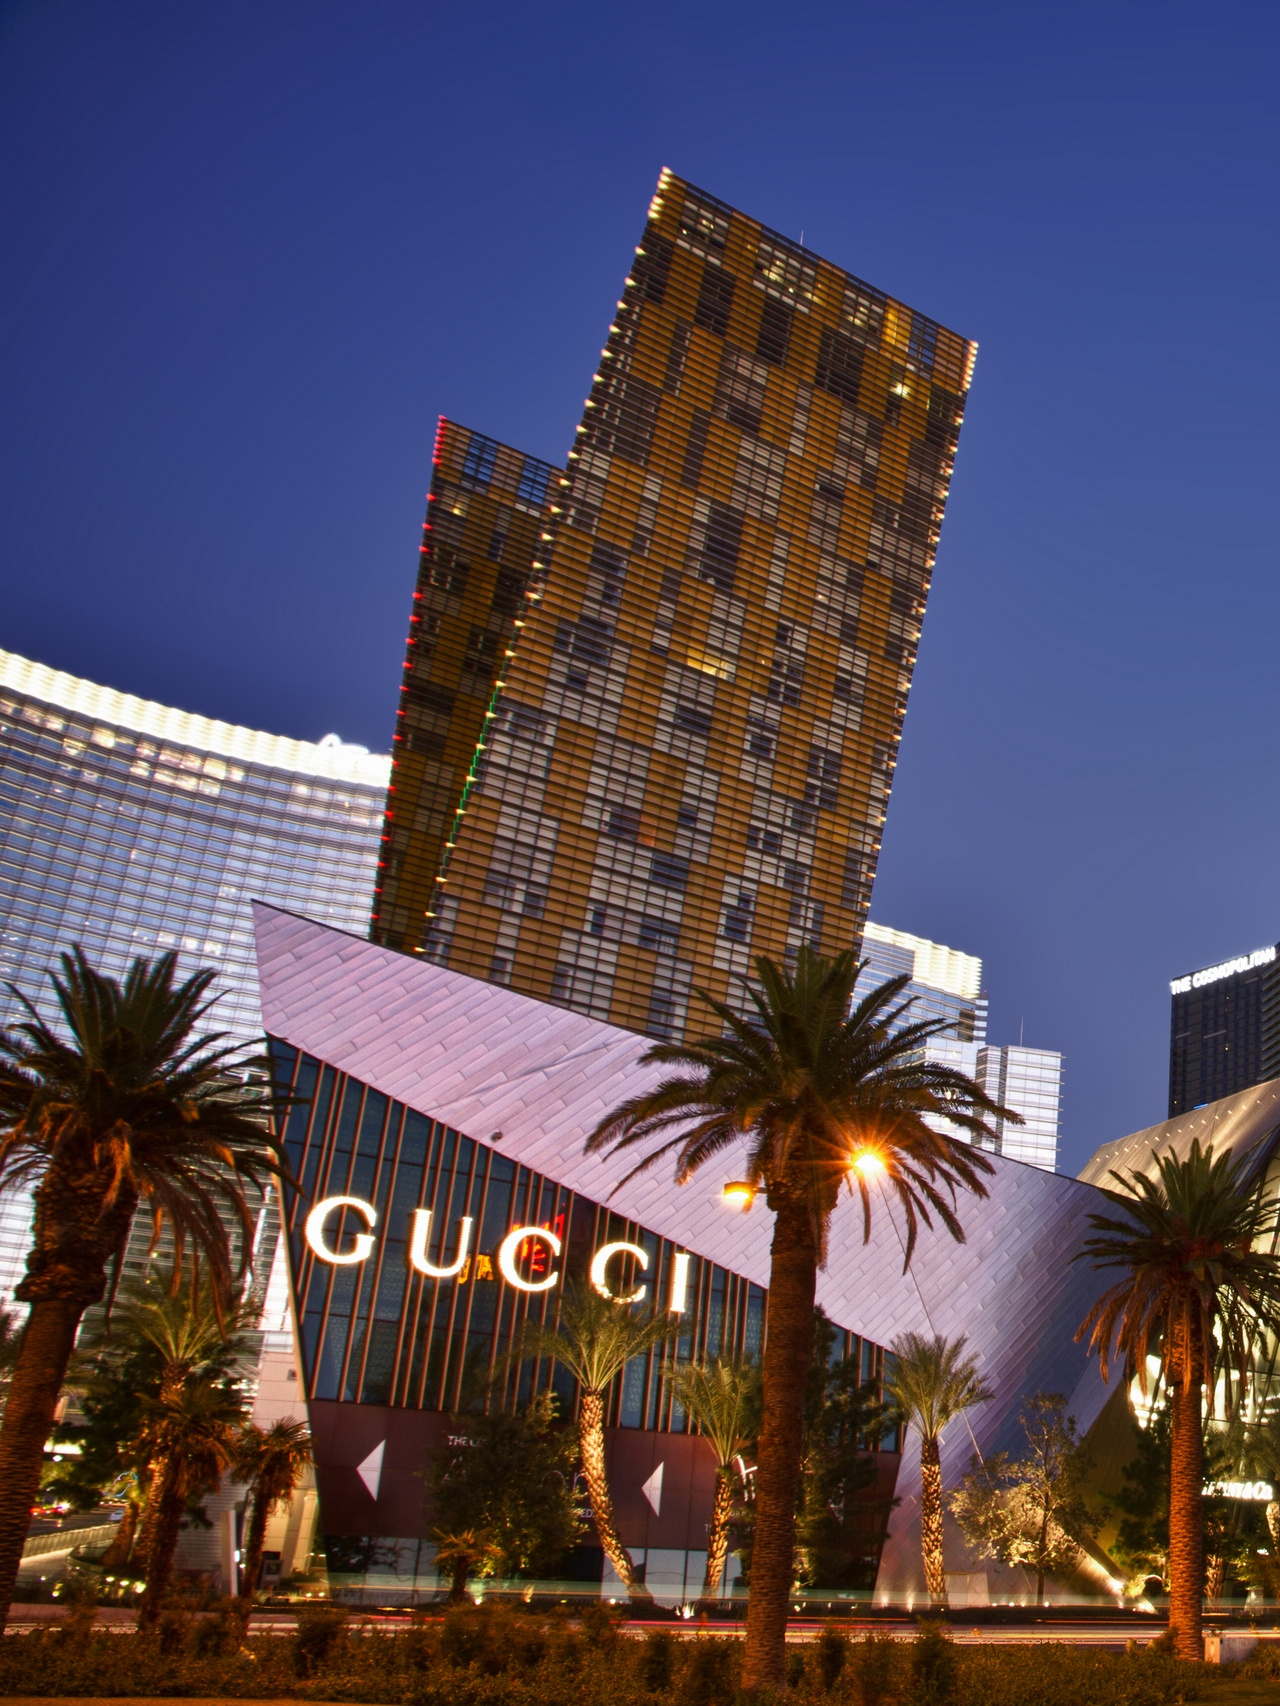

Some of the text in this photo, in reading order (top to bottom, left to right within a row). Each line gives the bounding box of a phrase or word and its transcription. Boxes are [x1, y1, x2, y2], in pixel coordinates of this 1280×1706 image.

[1170, 946, 1276, 996] THE COSMOPOLITAN
[305, 1195, 691, 1313] GUCCI
